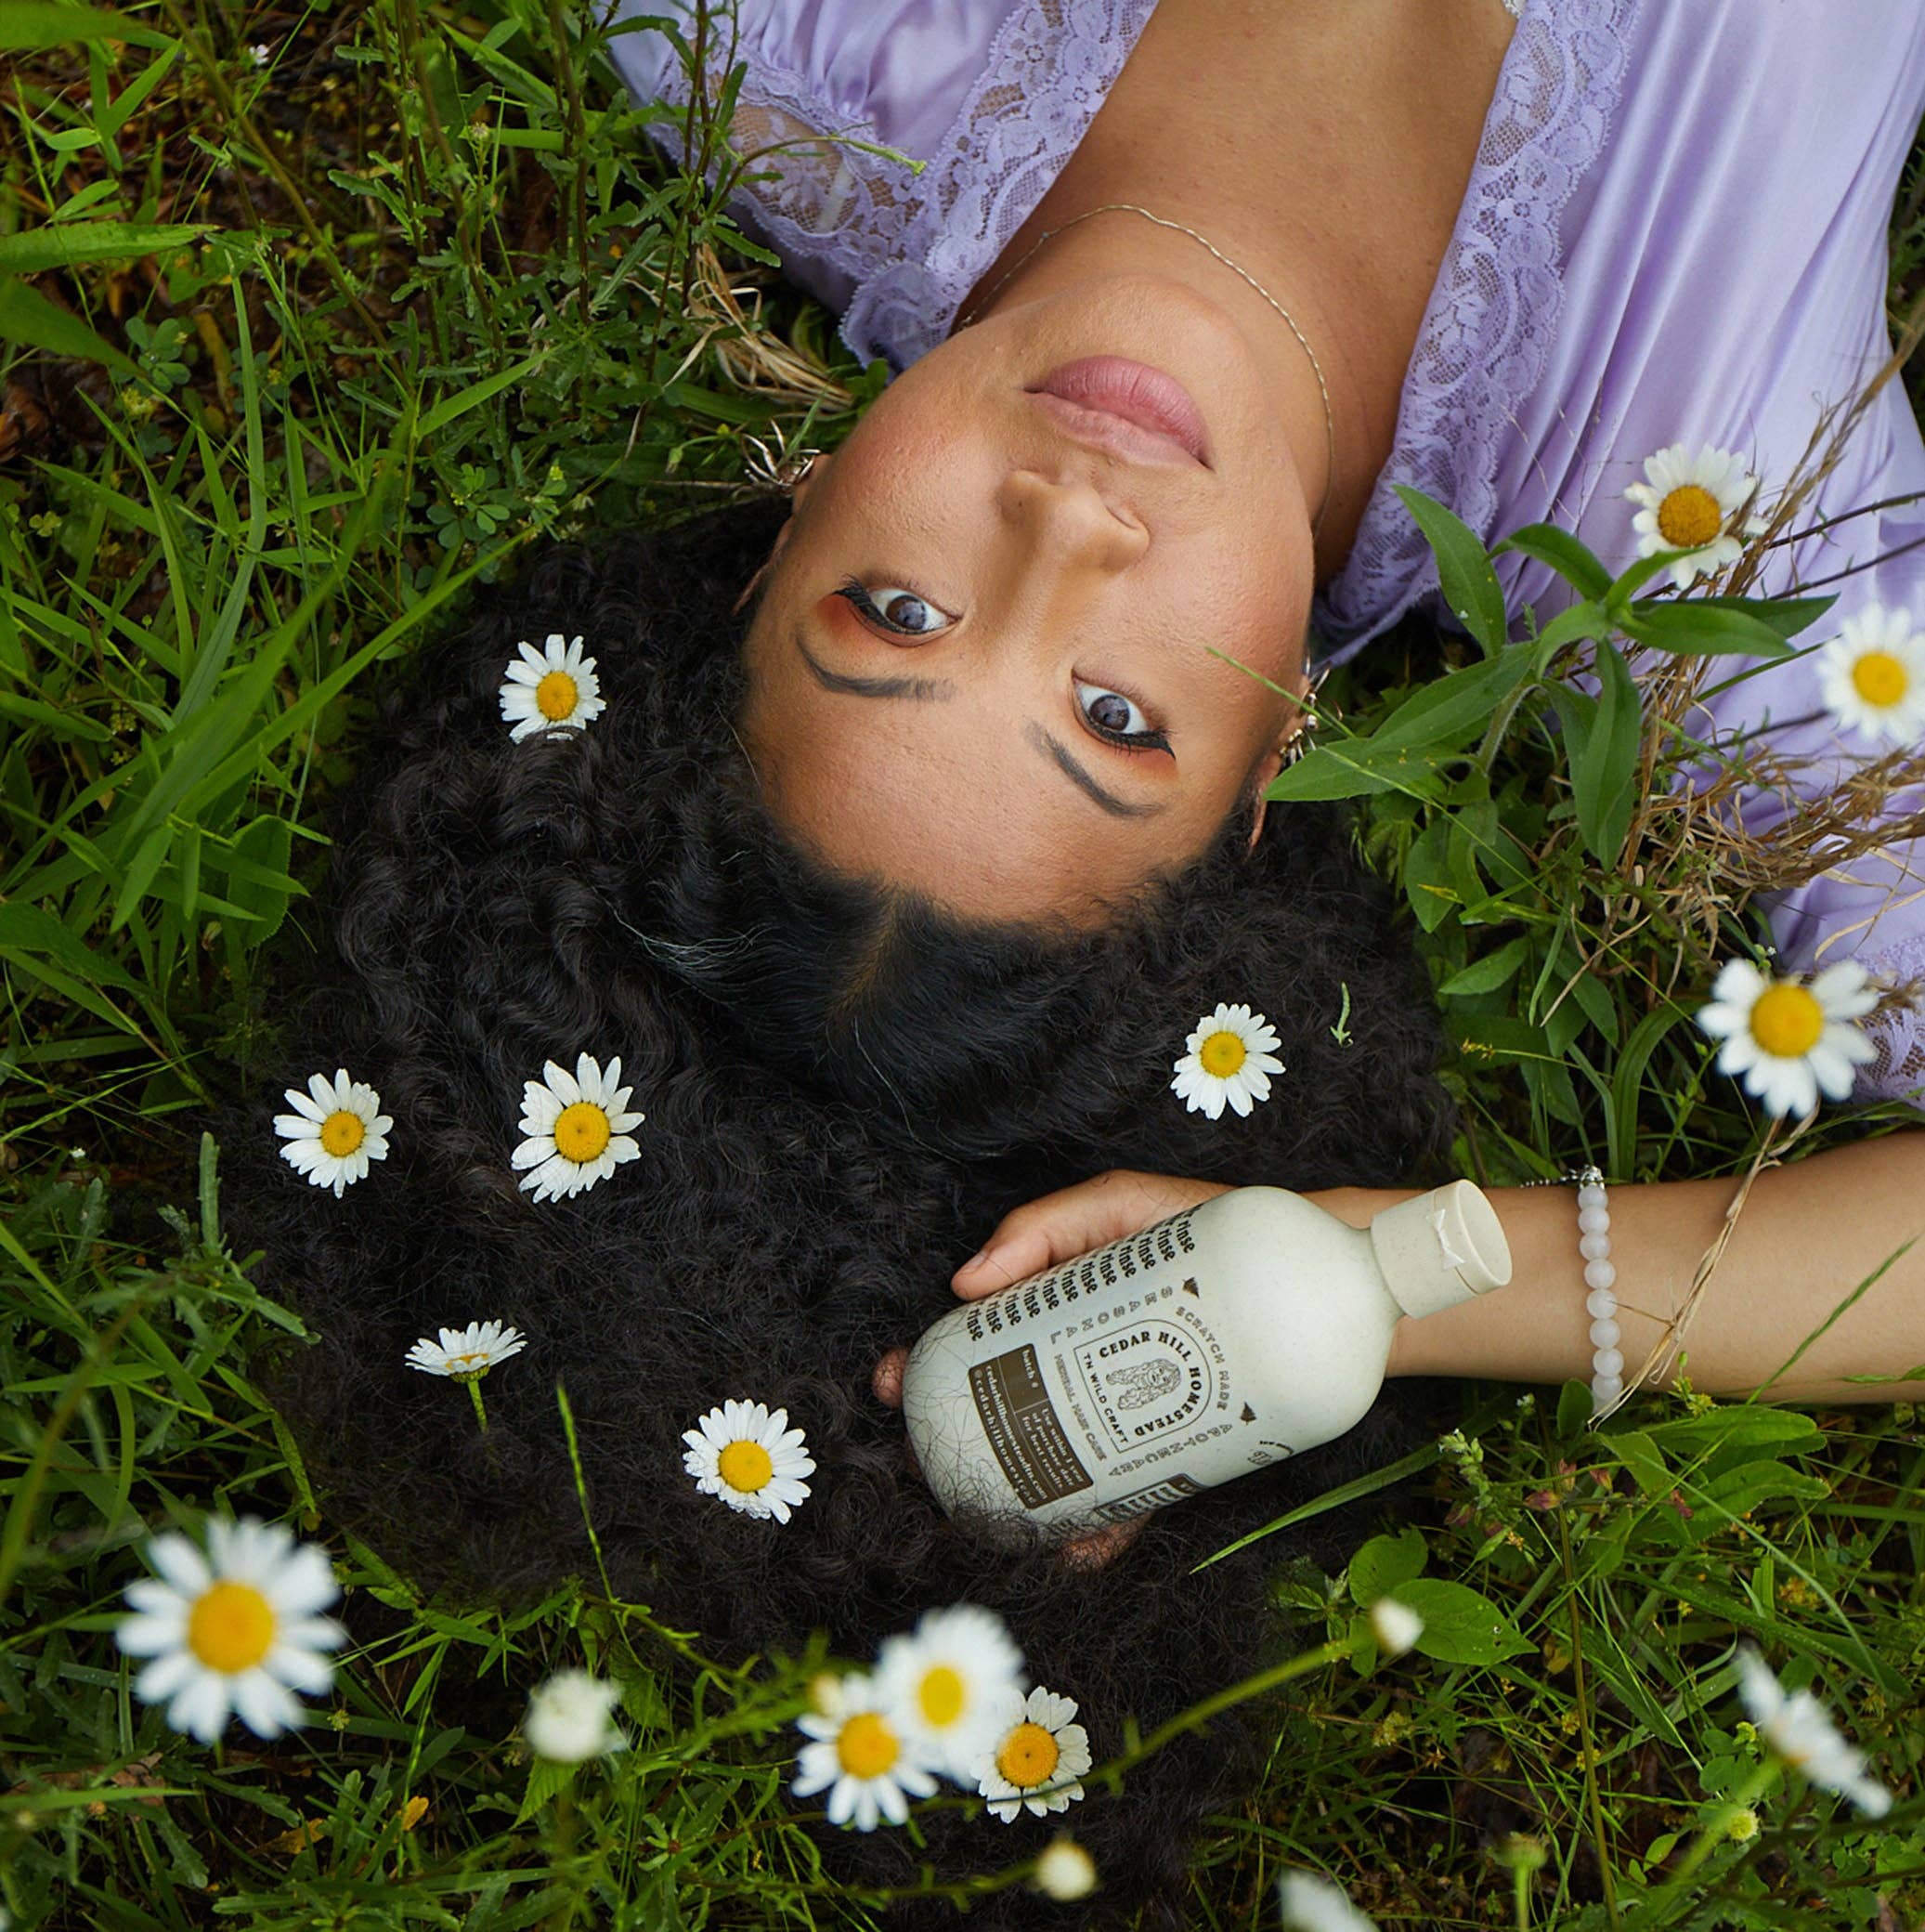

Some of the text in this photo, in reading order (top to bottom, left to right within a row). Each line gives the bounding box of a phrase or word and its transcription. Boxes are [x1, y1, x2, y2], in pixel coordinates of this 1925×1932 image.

[1138, 1236, 1156, 1270] rinse
[1157, 1228, 1176, 1261] rinse
[1177, 1221, 1195, 1253] rinse
[1080, 1260, 1099, 1294] rinse
[1099, 1252, 1117, 1286] rinse
[1119, 1245, 1137, 1278] rinse
[1023, 1286, 1041, 1318] rinse
[1043, 1277, 1060, 1311] rinse
[1061, 1270, 1079, 1302] rinse
[967, 1308, 983, 1342] rinse
[985, 1301, 1003, 1334] rinse
[1005, 1293, 1021, 1326] rinse
[1049, 1286, 1173, 1345] SEASONAL
[1099, 1331, 1151, 1358] CEDAR
[1157, 1331, 1191, 1362] HILL
[1176, 1306, 1230, 1411] SCRATCH MADE
[1022, 1349, 1035, 1379] batch
[1083, 1352, 1128, 1443] TN WILD CRAFT
[1134, 1366, 1203, 1436] HOMESTEAD
[985, 1364, 1048, 1500] cedarhillhomesteadtn.com
[1022, 1416, 1033, 1431] for
[1031, 1433, 1046, 1456] best
[1032, 1412, 1074, 1486] of purchase date
[1042, 1408, 1053, 1427] Use
[1050, 1428, 1067, 1456] within
[1070, 1466, 1085, 1483] year
[1109, 1423, 1233, 1477] APOTHECARY
